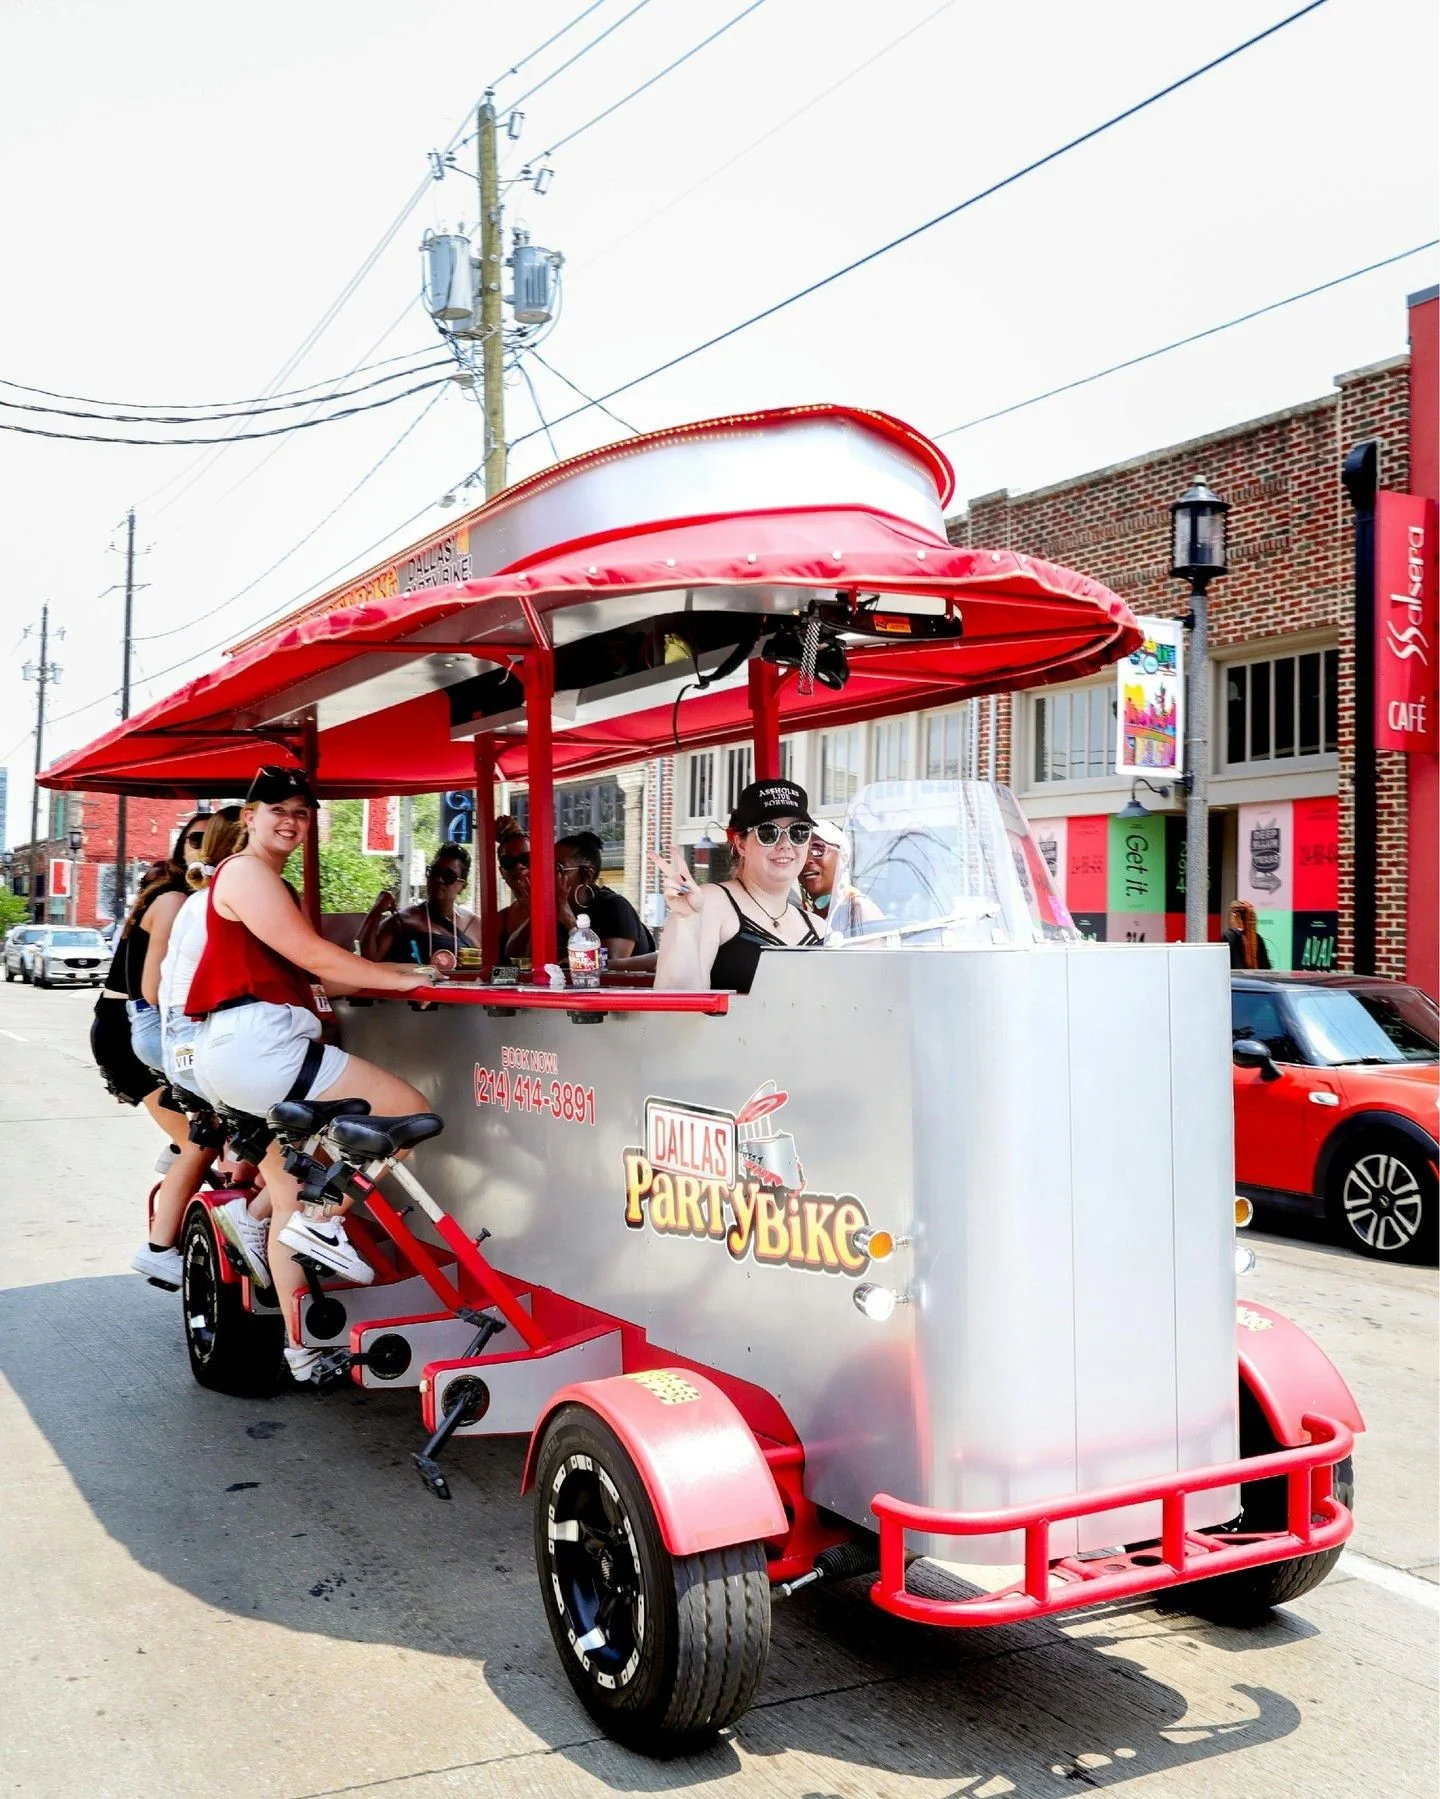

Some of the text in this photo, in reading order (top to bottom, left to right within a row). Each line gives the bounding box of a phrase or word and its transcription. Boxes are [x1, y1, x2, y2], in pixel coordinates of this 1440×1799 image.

[1387, 695, 1428, 733] CAFÉ
[759, 787, 800, 798] ASSHOLES
[1125, 834, 1149, 875] Get
[1125, 879, 1149, 897] it.
[501, 1046, 558, 1075] BOOK NOW!
[474, 1062, 596, 1126] (214) 414-3891
[654, 1115, 728, 1178] DALLAS
